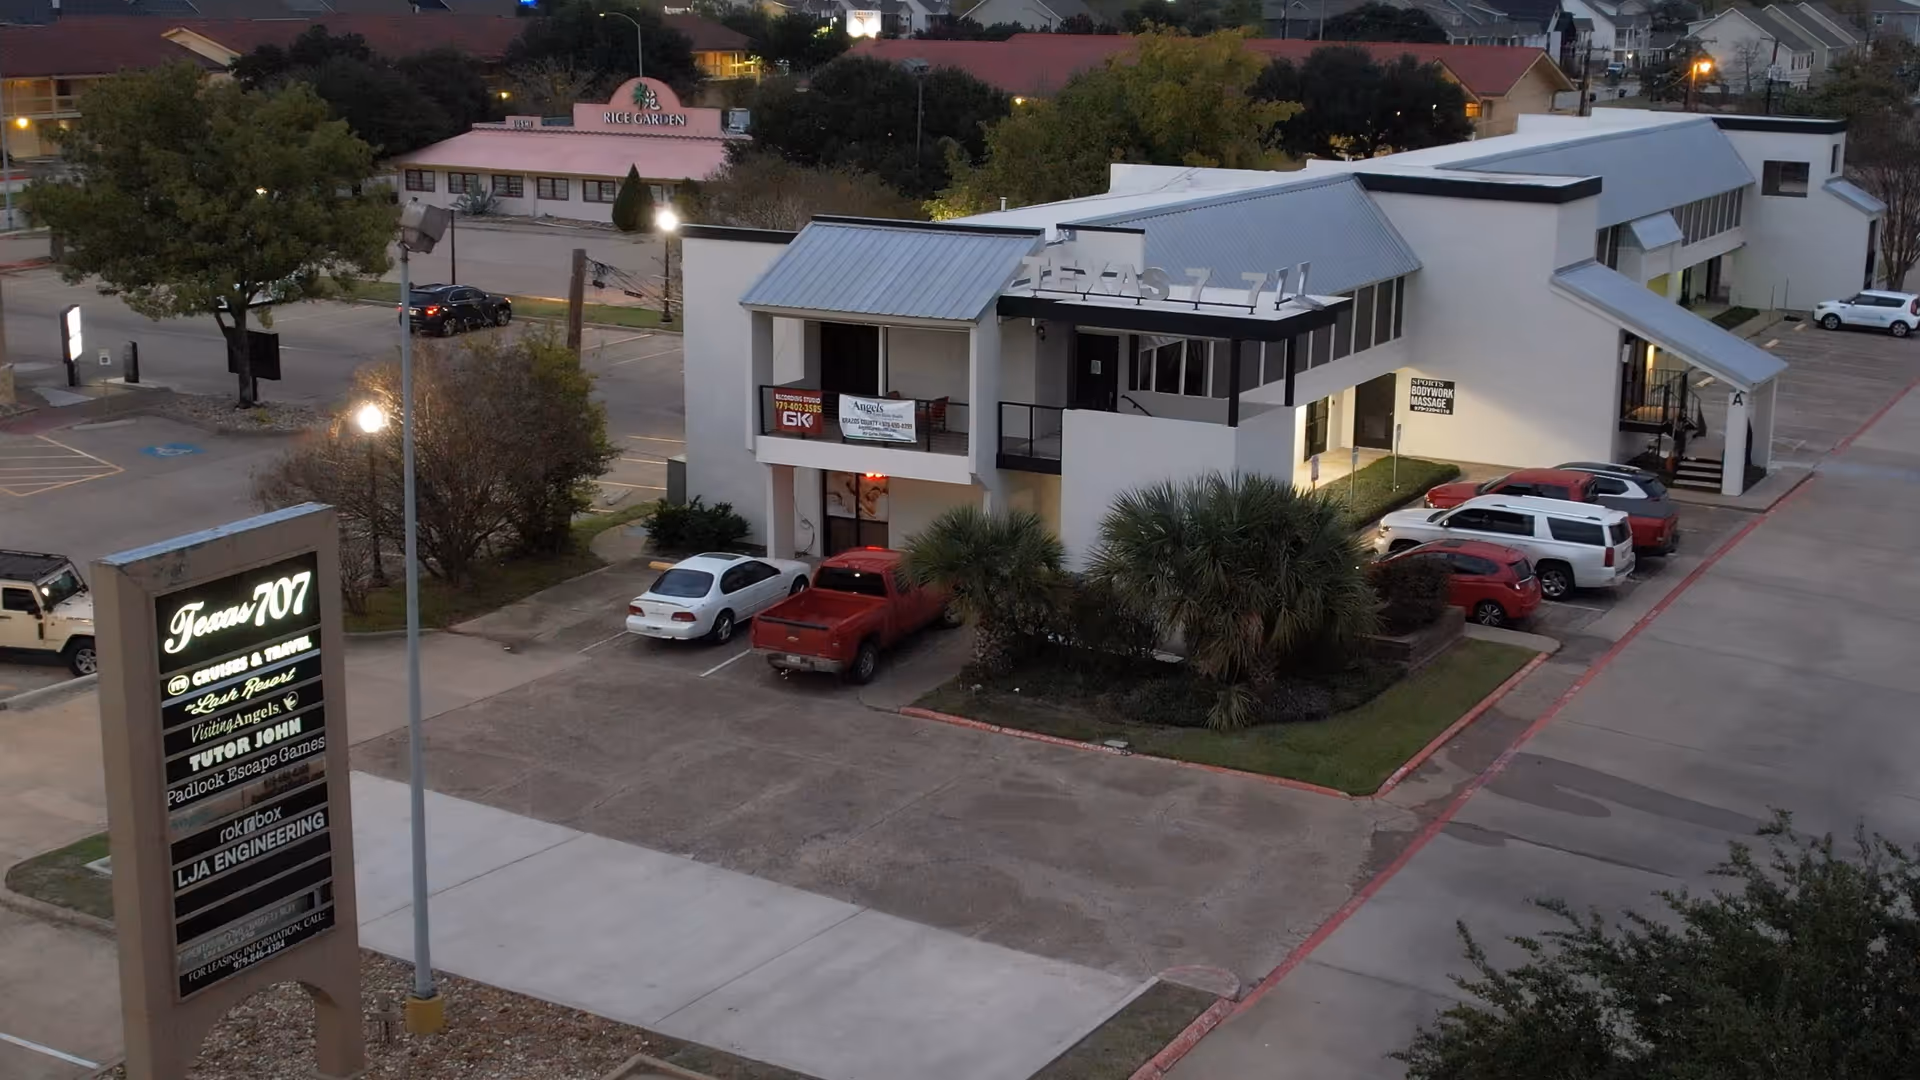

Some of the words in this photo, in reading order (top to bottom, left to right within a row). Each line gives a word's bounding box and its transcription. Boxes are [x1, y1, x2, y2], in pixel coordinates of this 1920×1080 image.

[603, 111, 631, 124] RICE
[633, 112, 687, 126] GARDEN
[1411, 386, 1453, 398] BODYWORK
[1411, 396, 1446, 408] MASSAGE
[1412, 379, 1444, 387] SPORTS
[1732, 393, 1743, 406] A
[853, 400, 884, 415] Angels
[164, 601, 255, 654] Texas
[253, 571, 311, 627] 707
[192, 656, 248, 686] CRUISES
[251, 652, 263, 667] &
[264, 636, 312, 662] TRAVEL
[191, 689, 239, 715] Lash
[242, 667, 296, 700] Resort
[189, 736, 251, 771] TUTOR
[255, 717, 302, 748] JOHN
[167, 770, 226, 806] Padlock
[227, 754, 278, 783] Escape
[279, 736, 325, 762] Games
[177, 860, 210, 888] LJA
[214, 812, 325, 872] ENGINEERING
[188, 967, 207, 982] FOR
[207, 949, 243, 974] LEASING
[304, 912, 326, 928] CALL:
